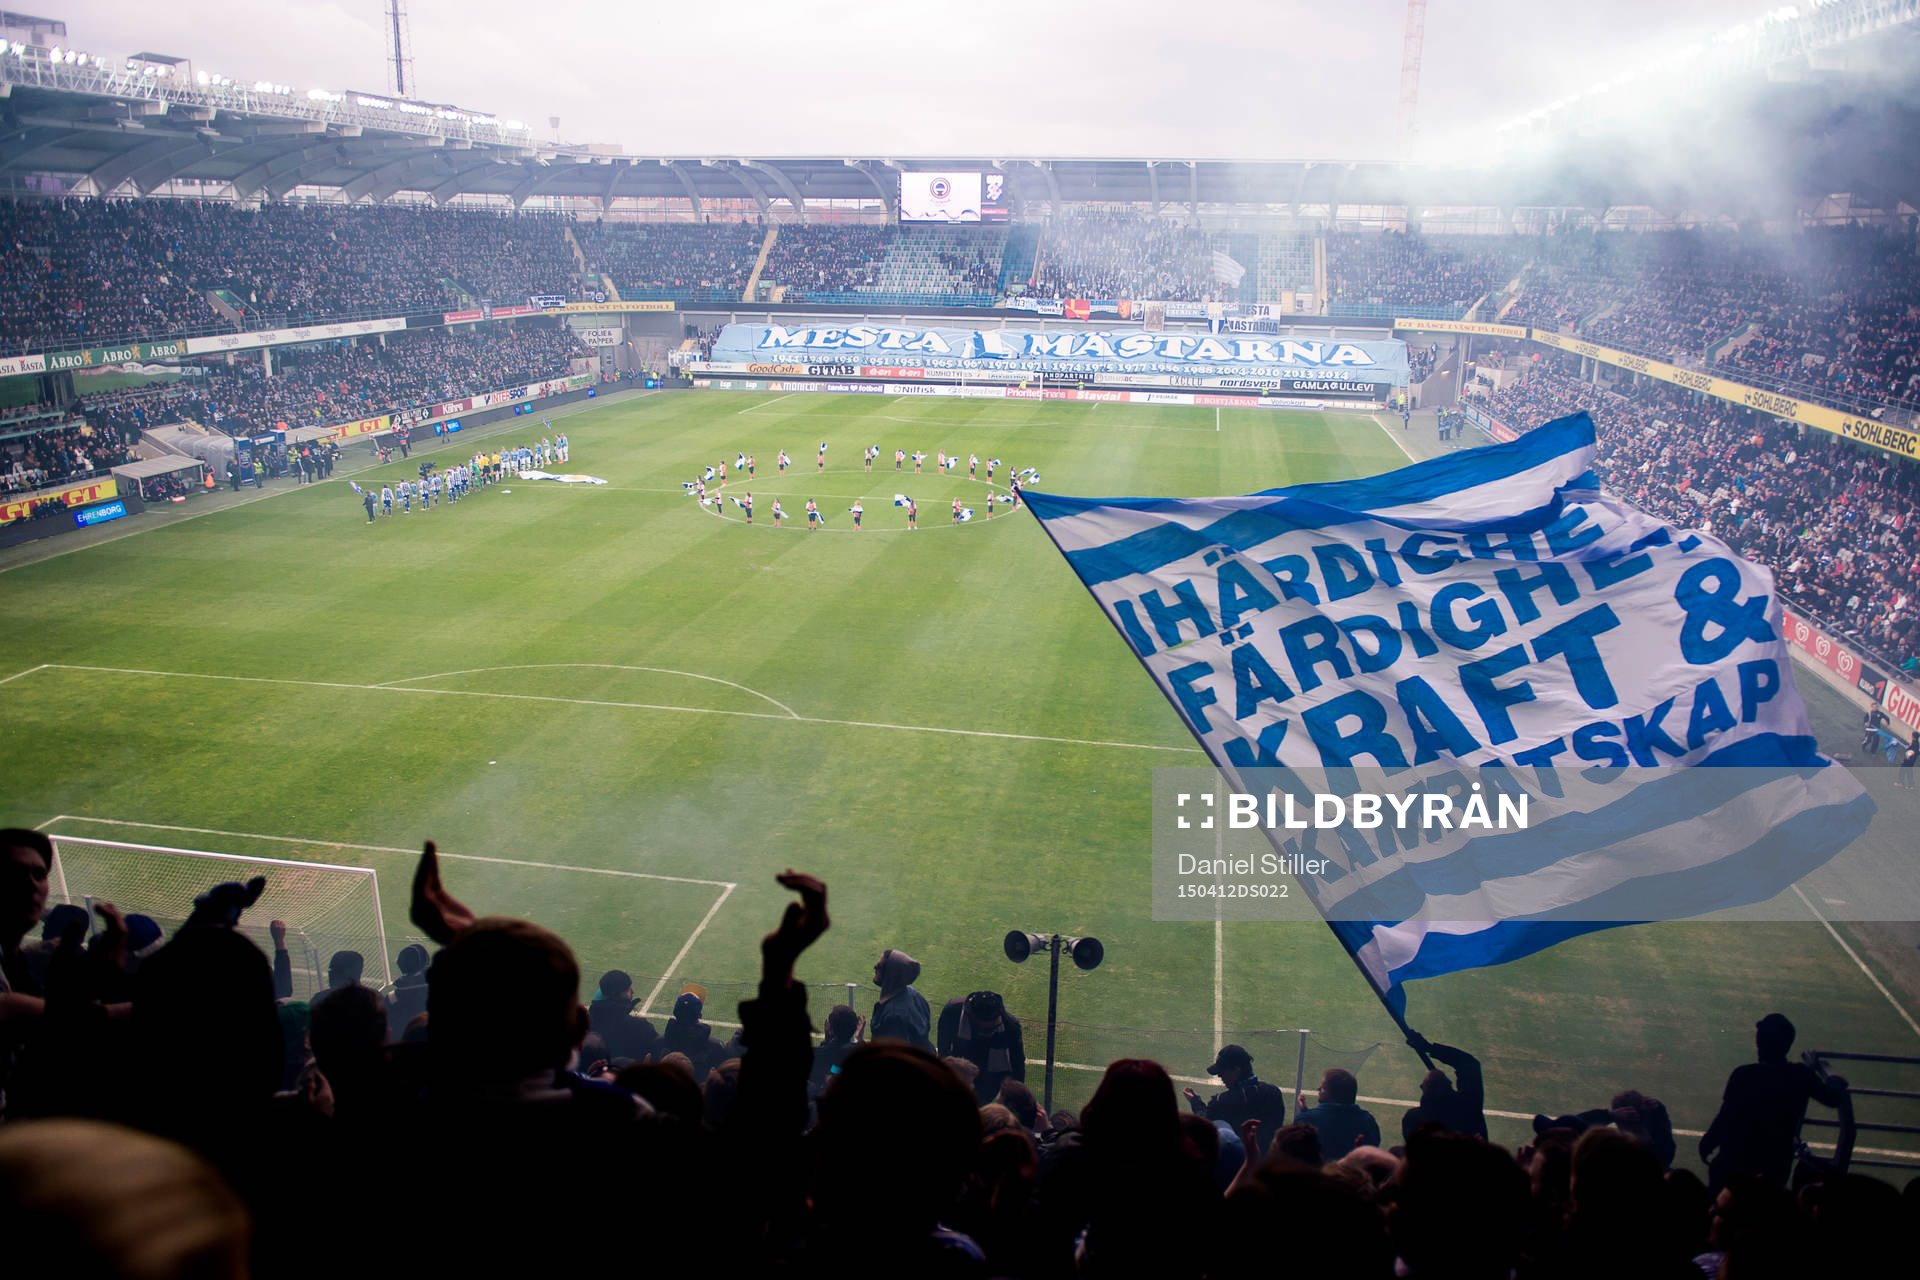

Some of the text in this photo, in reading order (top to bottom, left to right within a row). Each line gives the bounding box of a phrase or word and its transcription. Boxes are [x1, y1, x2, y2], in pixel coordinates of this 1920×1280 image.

[756, 323, 1378, 367] MESTA MÄSTARNA
[988, 361, 1016, 371] 1970
[491, 386, 528, 402] INTERSPORT
[1293, 380, 1375, 392] GAMLA ULLEVI
[1752, 391, 1798, 417] SOHLBERG
[359, 419, 382, 433] GT
[1853, 420, 1918, 455] SOHLBERG
[62, 484, 101, 507] GT
[77, 505, 122, 522] EHRENBORG
[1114, 505, 1606, 658] IHÄRDIGHE
[1167, 527, 1703, 735] FÄRDIGHE
[1222, 556, 1778, 829] KRAFT &
